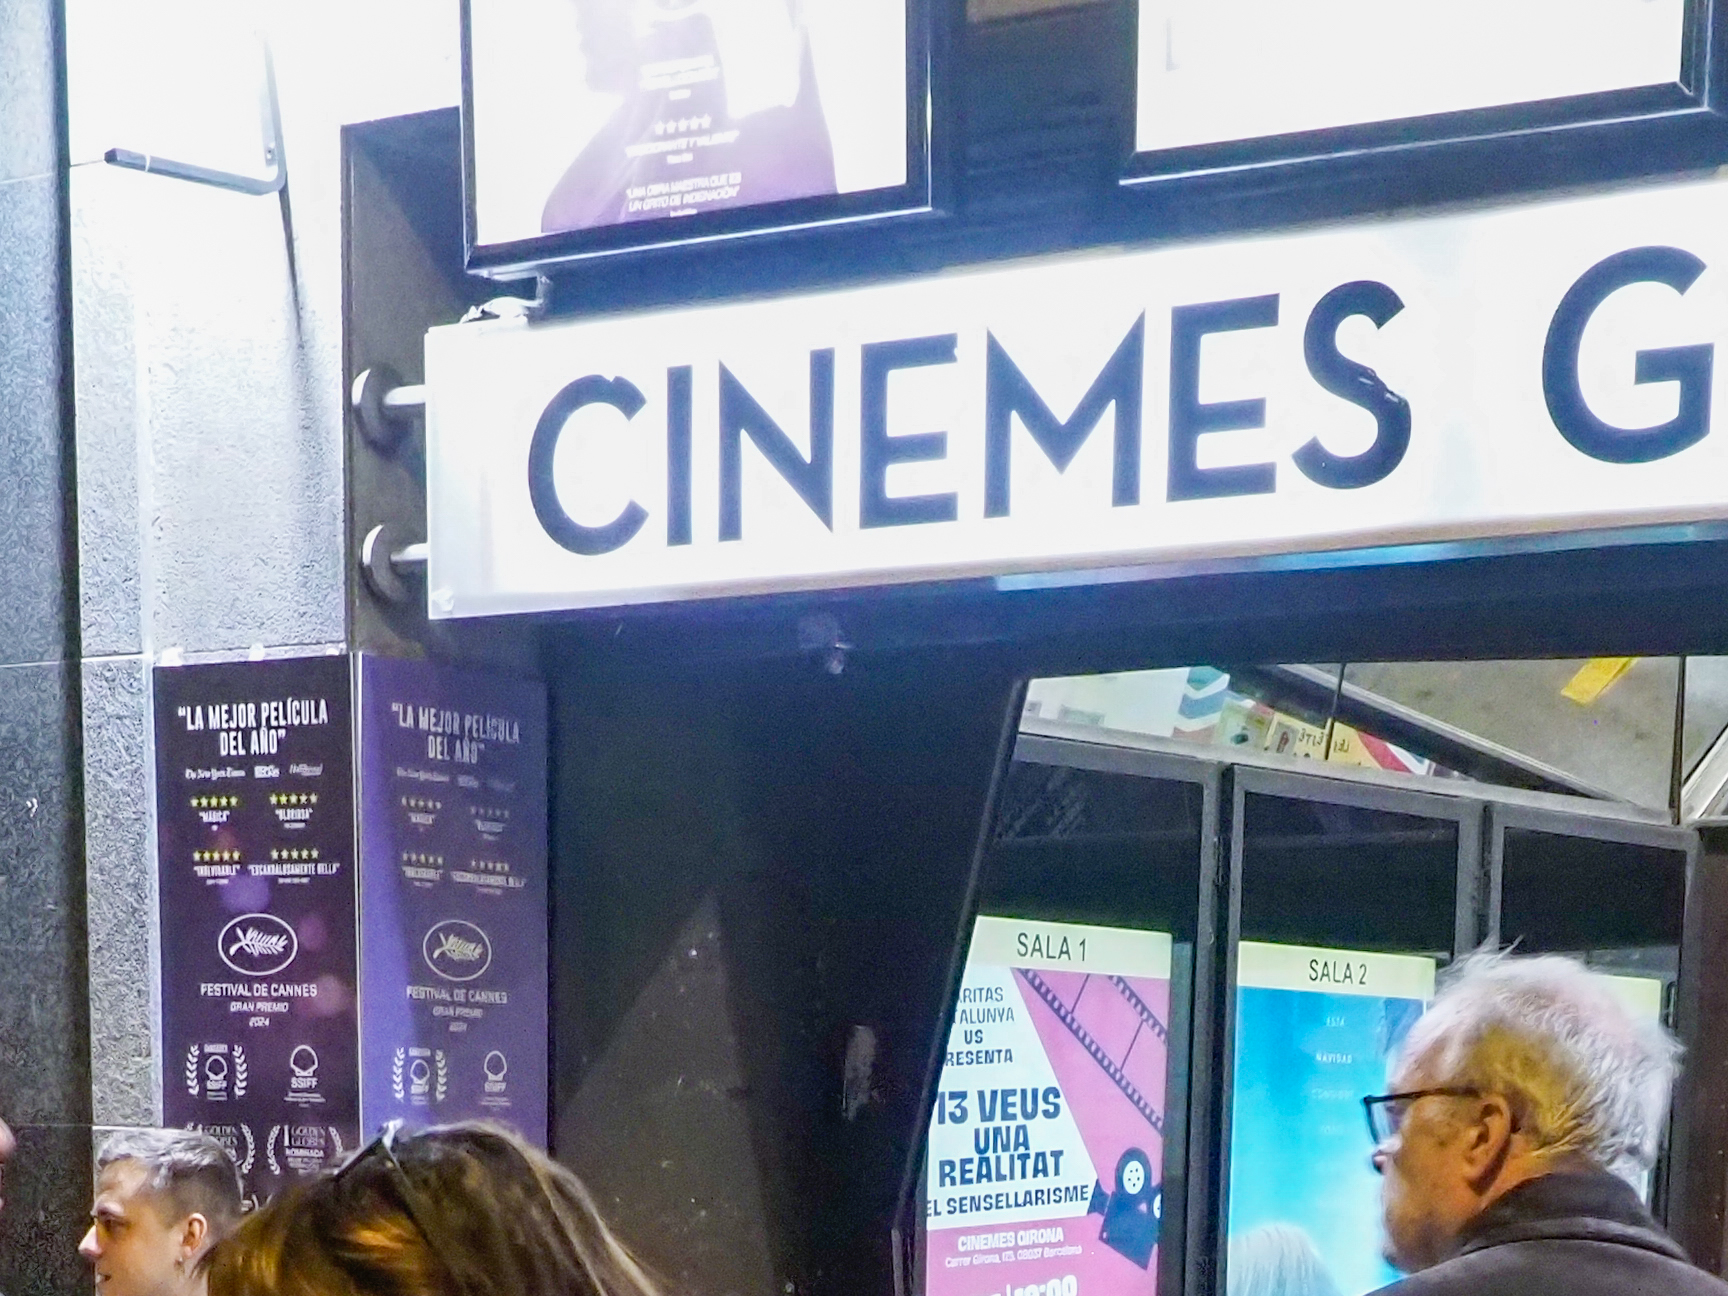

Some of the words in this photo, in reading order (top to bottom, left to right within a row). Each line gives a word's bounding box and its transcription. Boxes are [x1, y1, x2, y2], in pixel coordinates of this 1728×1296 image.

[528, 279, 1412, 557] CINEMES
[178, 705, 204, 730] “LA
[208, 702, 257, 729] MEJOR
[261, 697, 329, 727] PELÍCULA
[419, 706, 460, 735] MEJOR
[220, 730, 246, 756] DEL
[250, 726, 286, 756] AÑO”
[428, 735, 450, 761] DEL
[1016, 932, 1072, 961] SALA
[1079, 938, 1087, 962] 1
[1309, 959, 1353, 985] SALA
[1359, 963, 1367, 985] 2
[200, 983, 252, 997] FESTIVAL
[254, 983, 268, 997] DE
[271, 982, 318, 997] CANNES
[964, 1029, 983, 1044] US
[946, 1049, 1013, 1067] RESENTA
[290, 1077, 318, 1089] SSIFF
[937, 1090, 968, 1125] 13
[977, 1086, 1061, 1123] VEUS
[974, 1124, 1030, 1155] UNA
[939, 1149, 1064, 1188] REALITAT
[947, 1184, 1089, 1215] SENSELLARISME
[958, 1231, 1015, 1251] CINEMES
[1017, 1227, 1064, 1248] GIRONA
